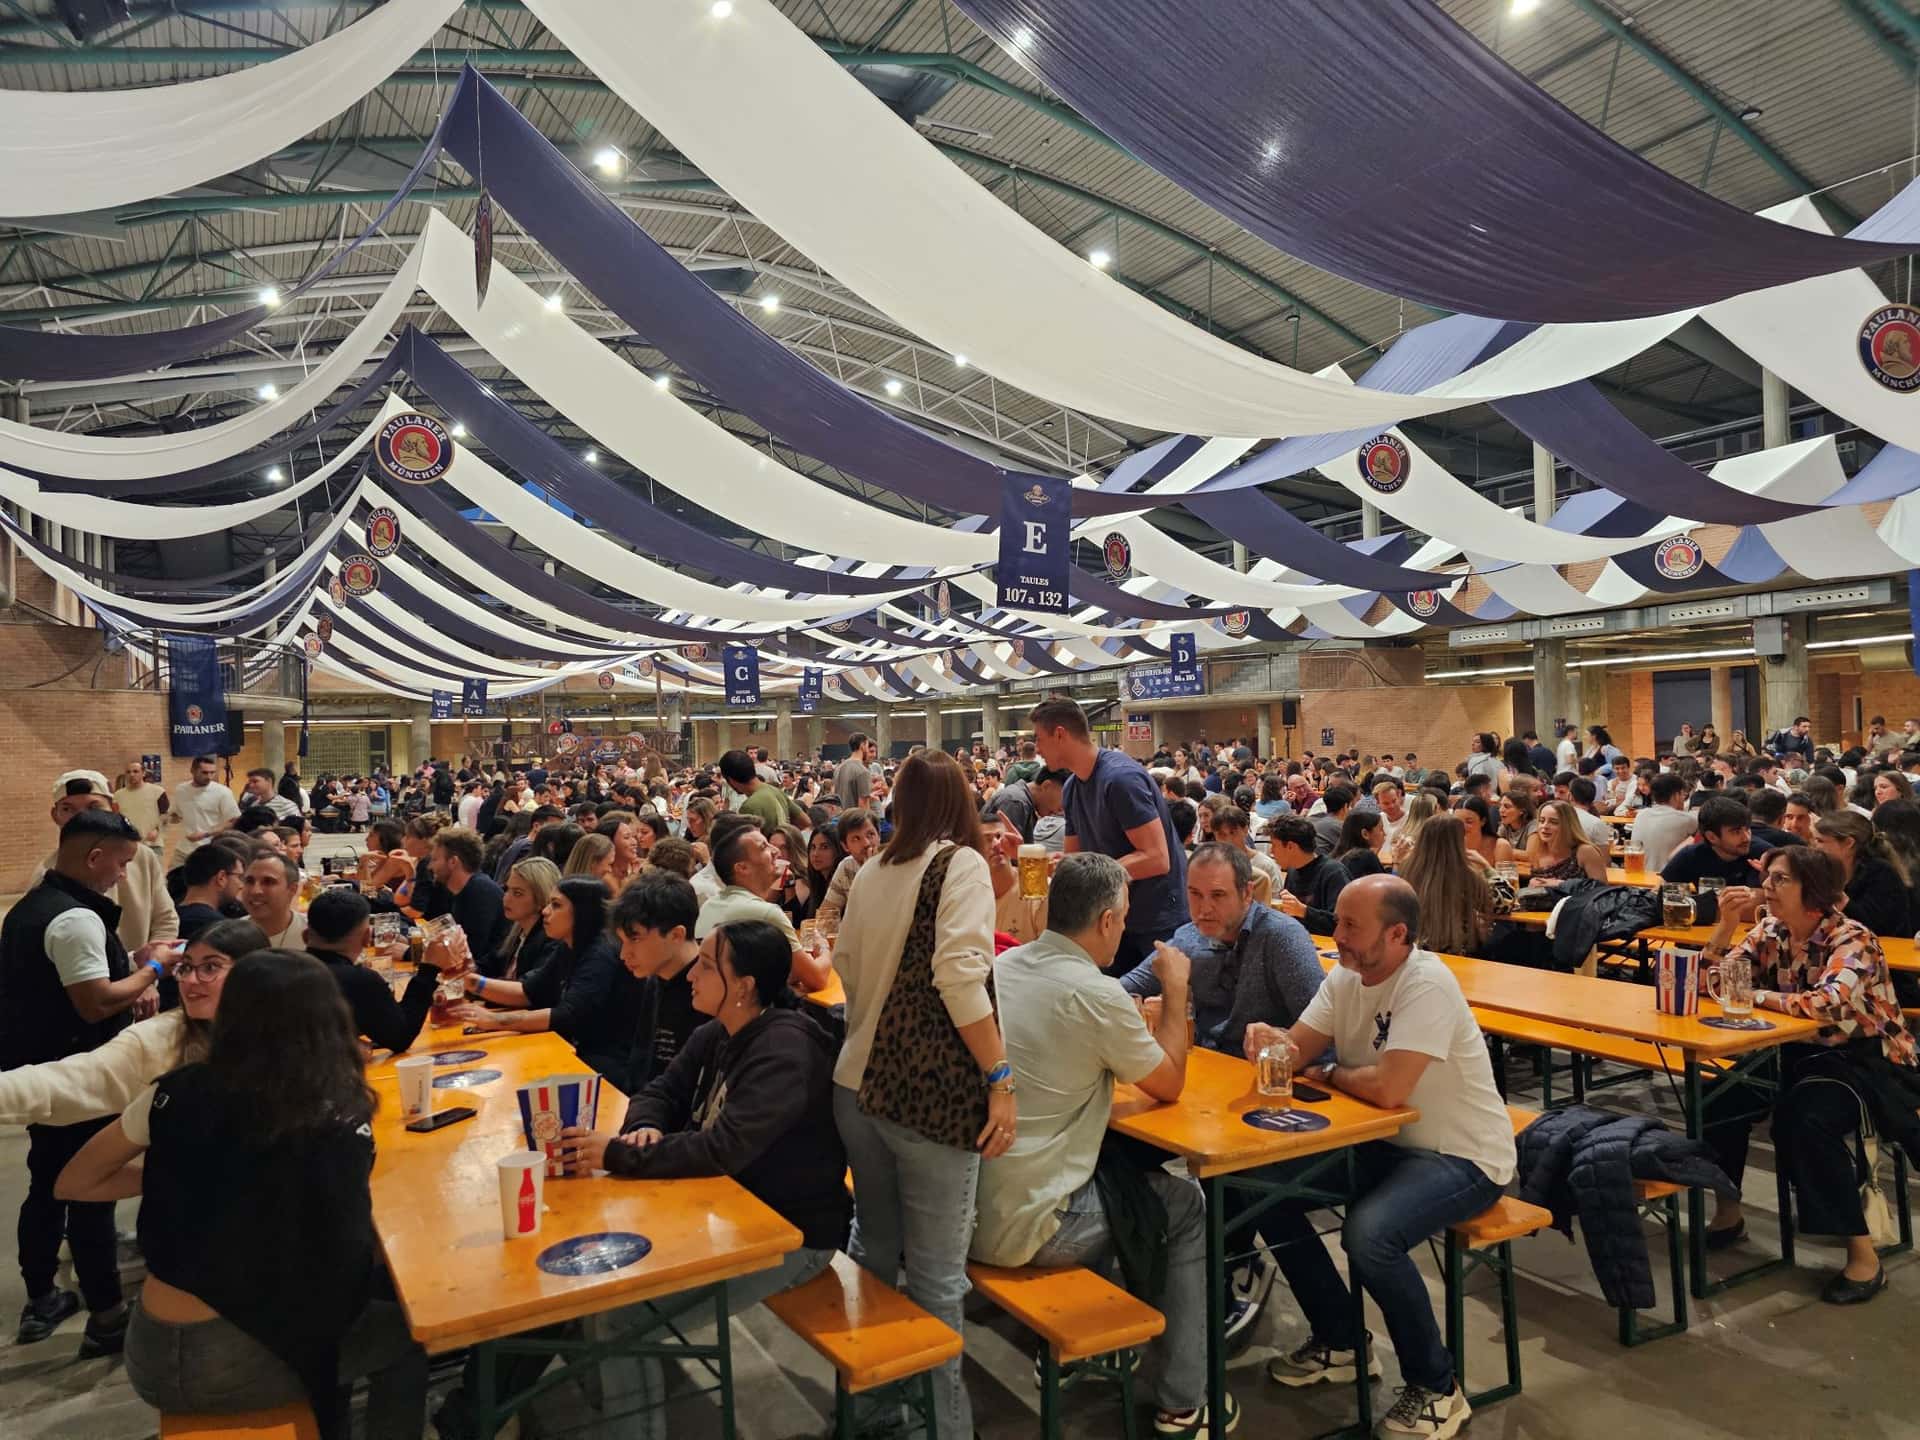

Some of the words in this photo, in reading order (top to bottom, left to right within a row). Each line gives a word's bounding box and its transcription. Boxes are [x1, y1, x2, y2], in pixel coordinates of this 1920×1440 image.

[1862, 309, 1920, 340] PAULAN
[382, 415, 447, 442] PAULANER
[1361, 436, 1406, 457] PAULANER
[1022, 520, 1047, 555] E
[1020, 575, 1049, 586] TAULES
[1004, 587, 1027, 603] 107
[1028, 596, 1035, 604] a
[1038, 591, 1063, 607] 132
[1178, 650, 1189, 663] D
[735, 666, 749, 681] C
[435, 699, 451, 707] VIP
[174, 722, 225, 735] PAULANER
